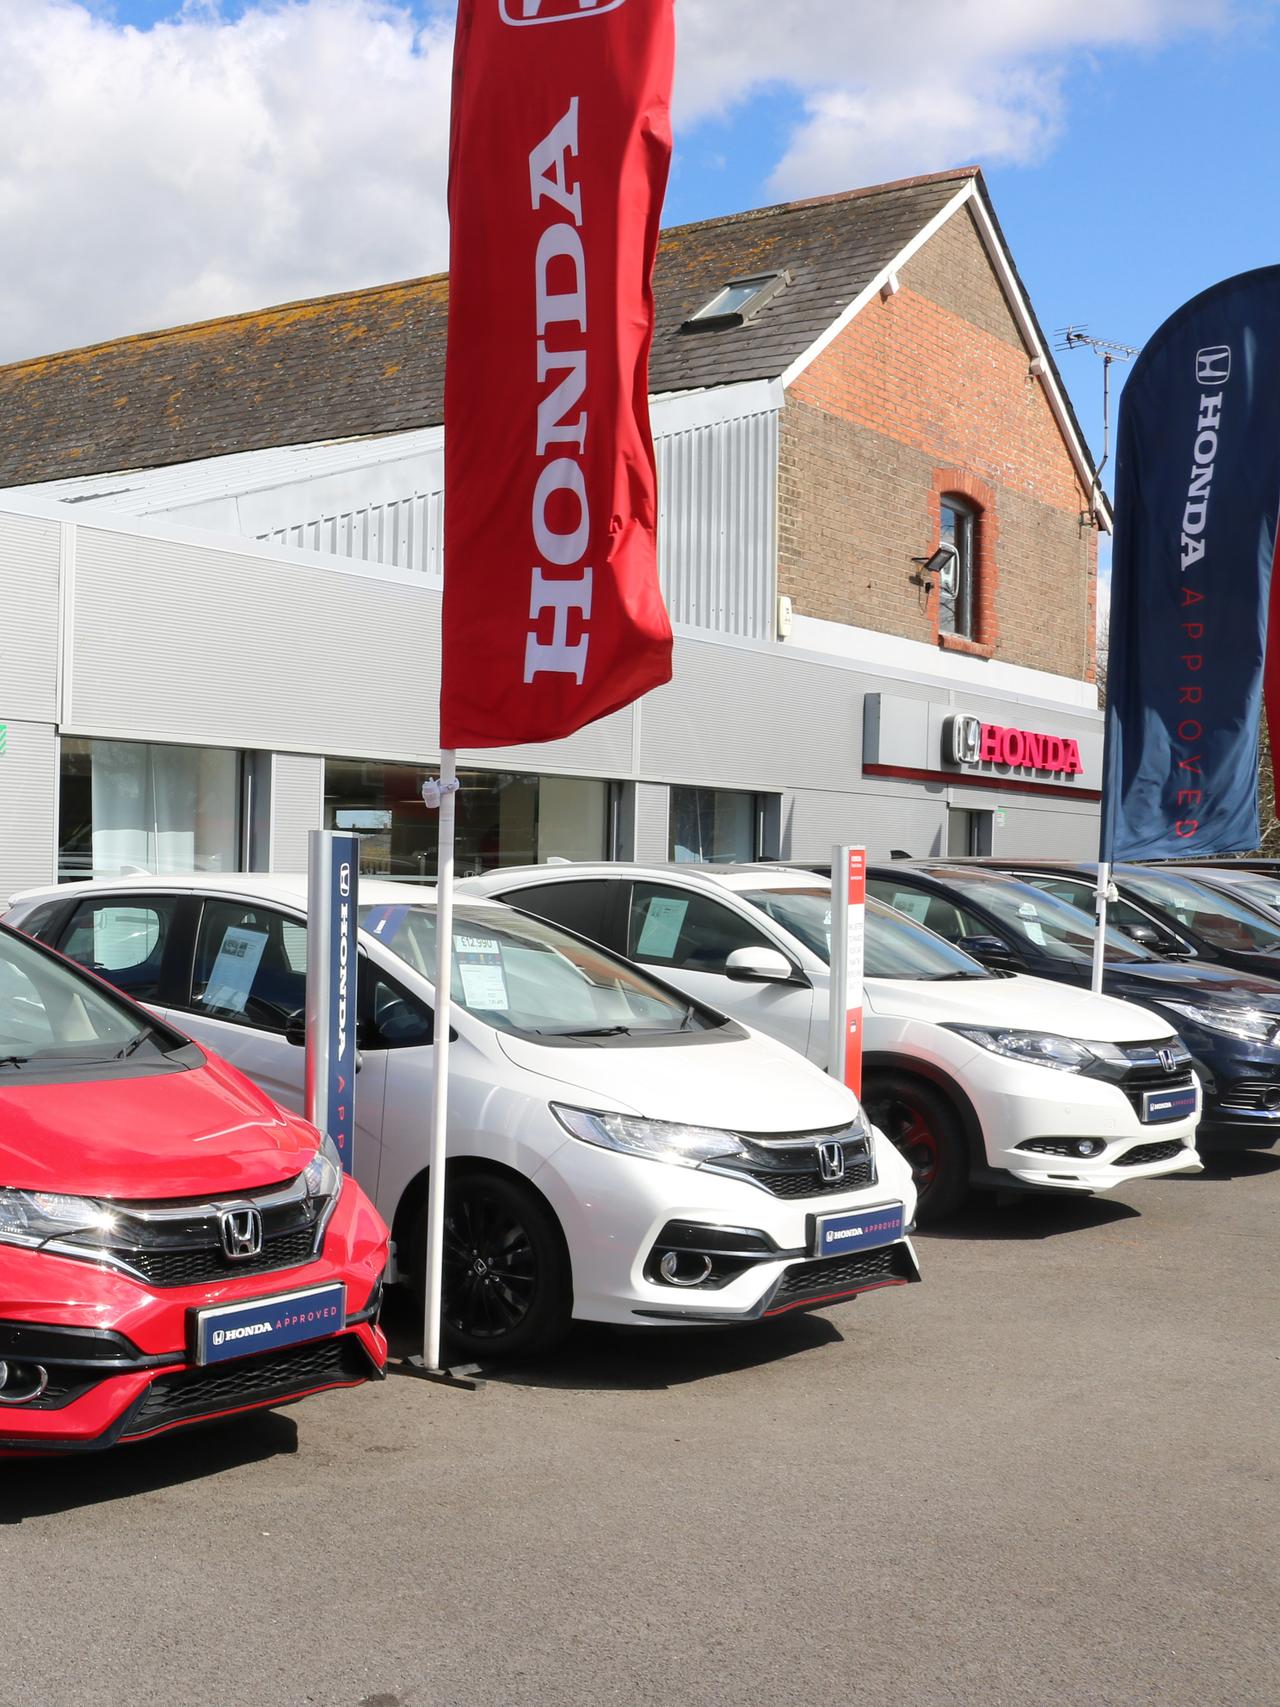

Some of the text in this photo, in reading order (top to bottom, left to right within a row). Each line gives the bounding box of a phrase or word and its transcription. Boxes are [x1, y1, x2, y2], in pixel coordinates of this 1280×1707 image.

[523, 97, 594, 685] HONDA
[1175, 391, 1223, 838] HONDA APPROVED
[980, 723, 1085, 775] HONDA
[338, 903, 349, 1062] HONDA
[833, 1227, 863, 1240] HONDA
[225, 1306, 337, 1341] HONDA APPROVED
